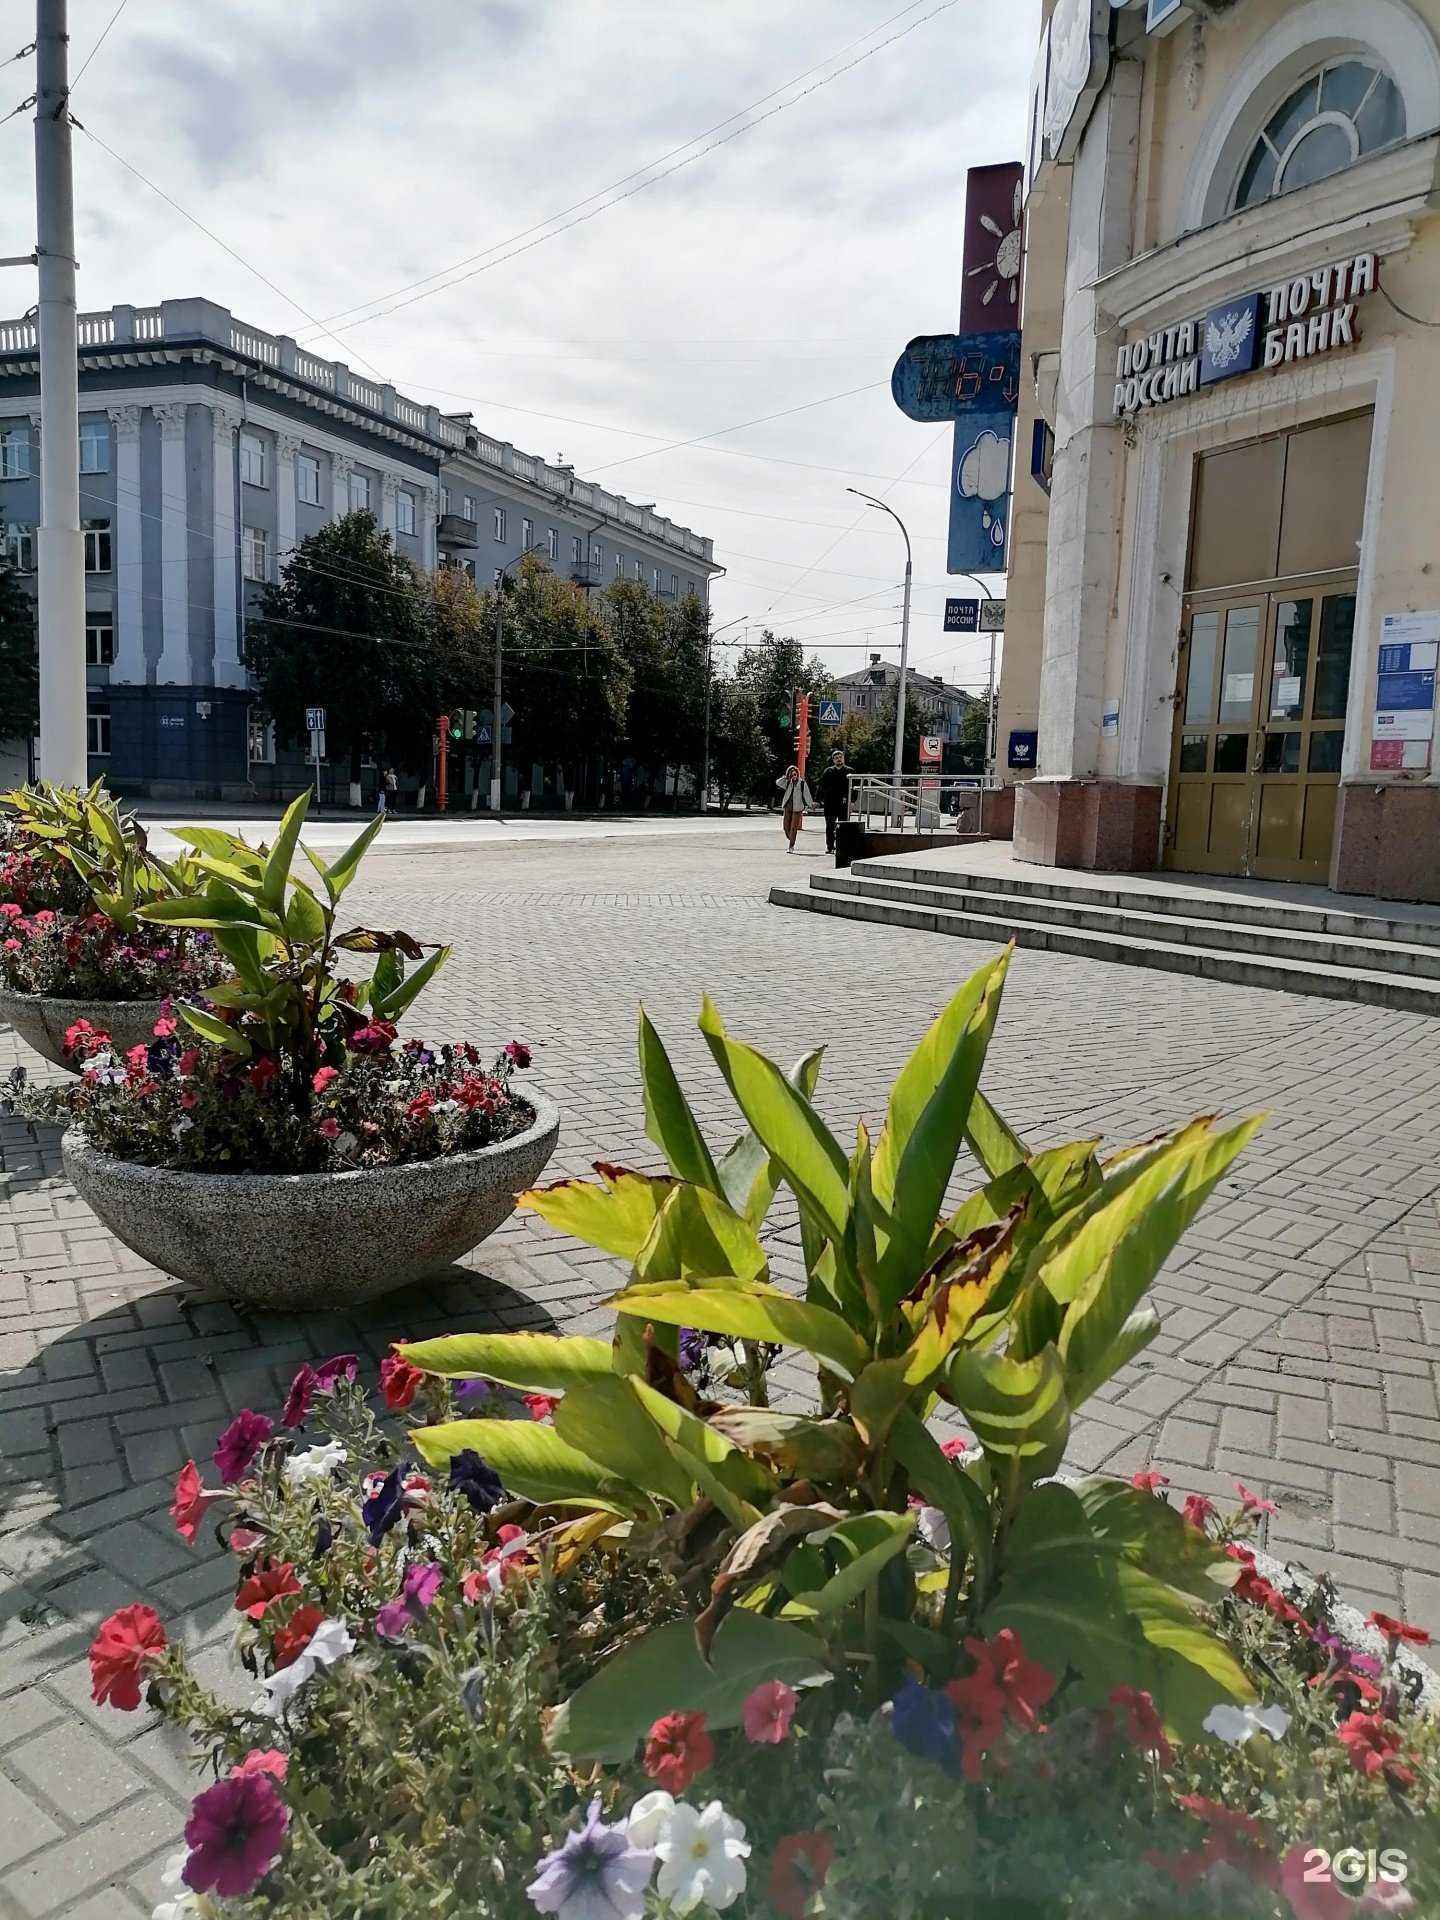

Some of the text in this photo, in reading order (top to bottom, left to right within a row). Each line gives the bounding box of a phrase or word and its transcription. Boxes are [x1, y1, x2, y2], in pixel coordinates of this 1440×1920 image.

[1267, 254, 1378, 324] ПОЧТА
[1116, 320, 1196, 379] ПОЧТА
[1263, 303, 1358, 369] БАНК
[1112, 358, 1198, 416] РОССИИ
[947, 616, 974, 624] РОССИИ
[948, 606, 974, 615] ПОЧТА
